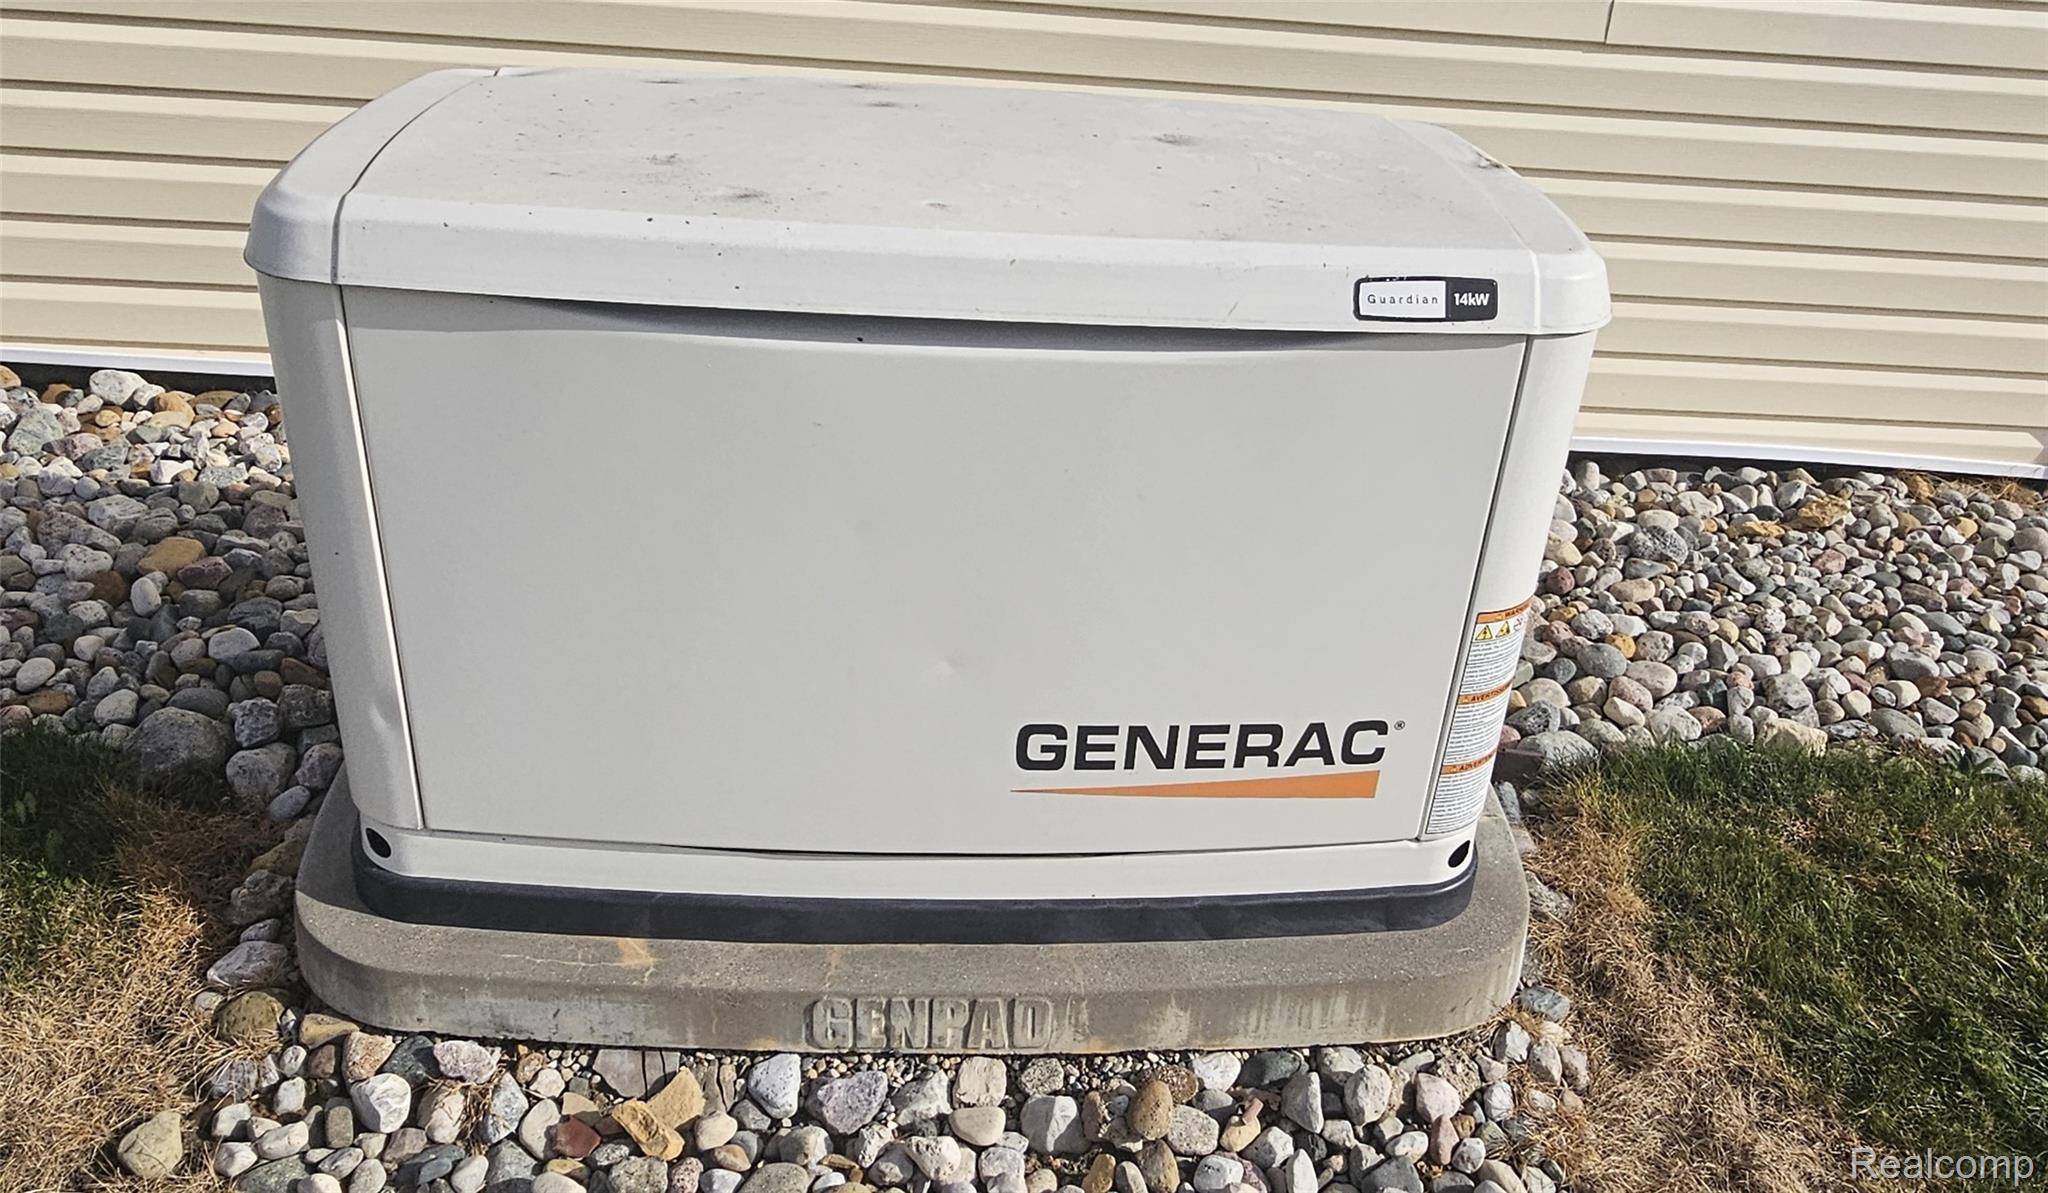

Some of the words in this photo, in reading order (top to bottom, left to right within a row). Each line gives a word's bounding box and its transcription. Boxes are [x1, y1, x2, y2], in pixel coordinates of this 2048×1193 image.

[1367, 293, 1439, 305] Guardian
[1454, 292, 1490, 306] 14kW
[1015, 719, 1389, 771] GENERAC
[805, 997, 1053, 1050] GENPAD
